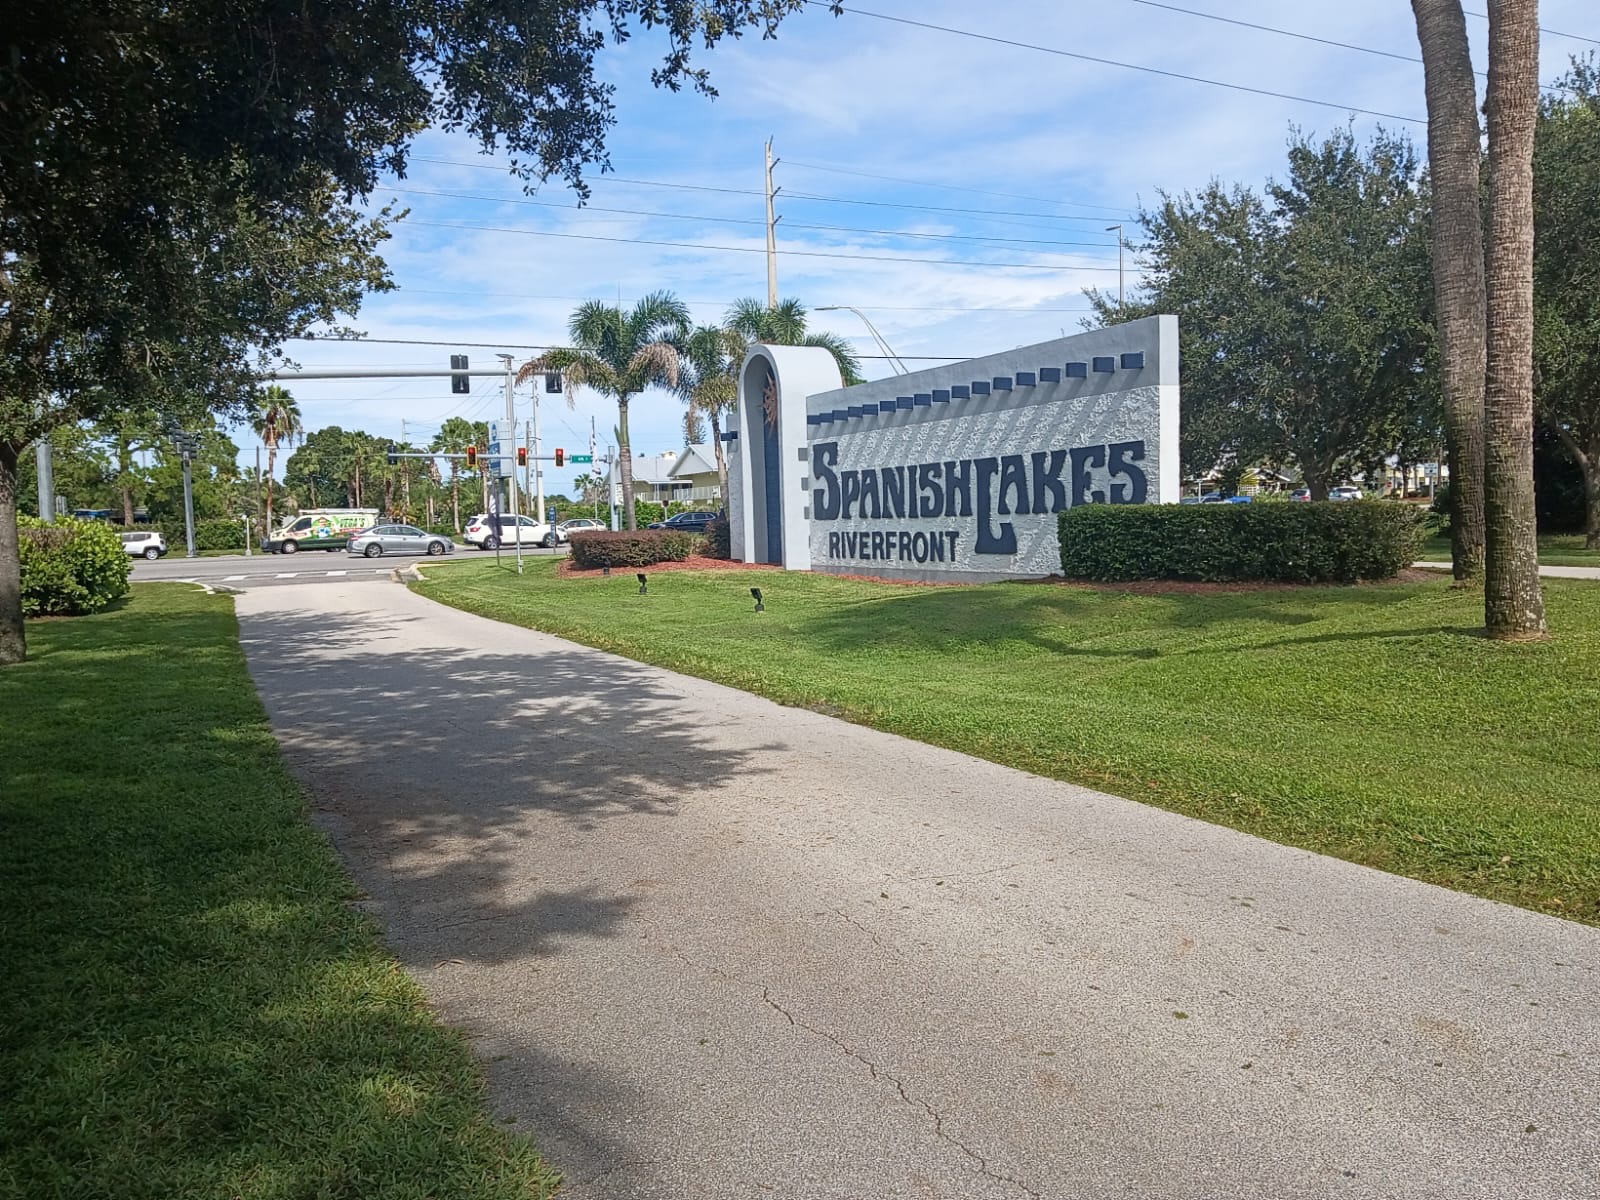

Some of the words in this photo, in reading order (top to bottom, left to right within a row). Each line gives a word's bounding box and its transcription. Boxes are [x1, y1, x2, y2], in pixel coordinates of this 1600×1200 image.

[812, 442, 972, 520] SPANISH
[974, 440, 1147, 554] LAKES
[830, 531, 959, 563] RIVERFRONT
